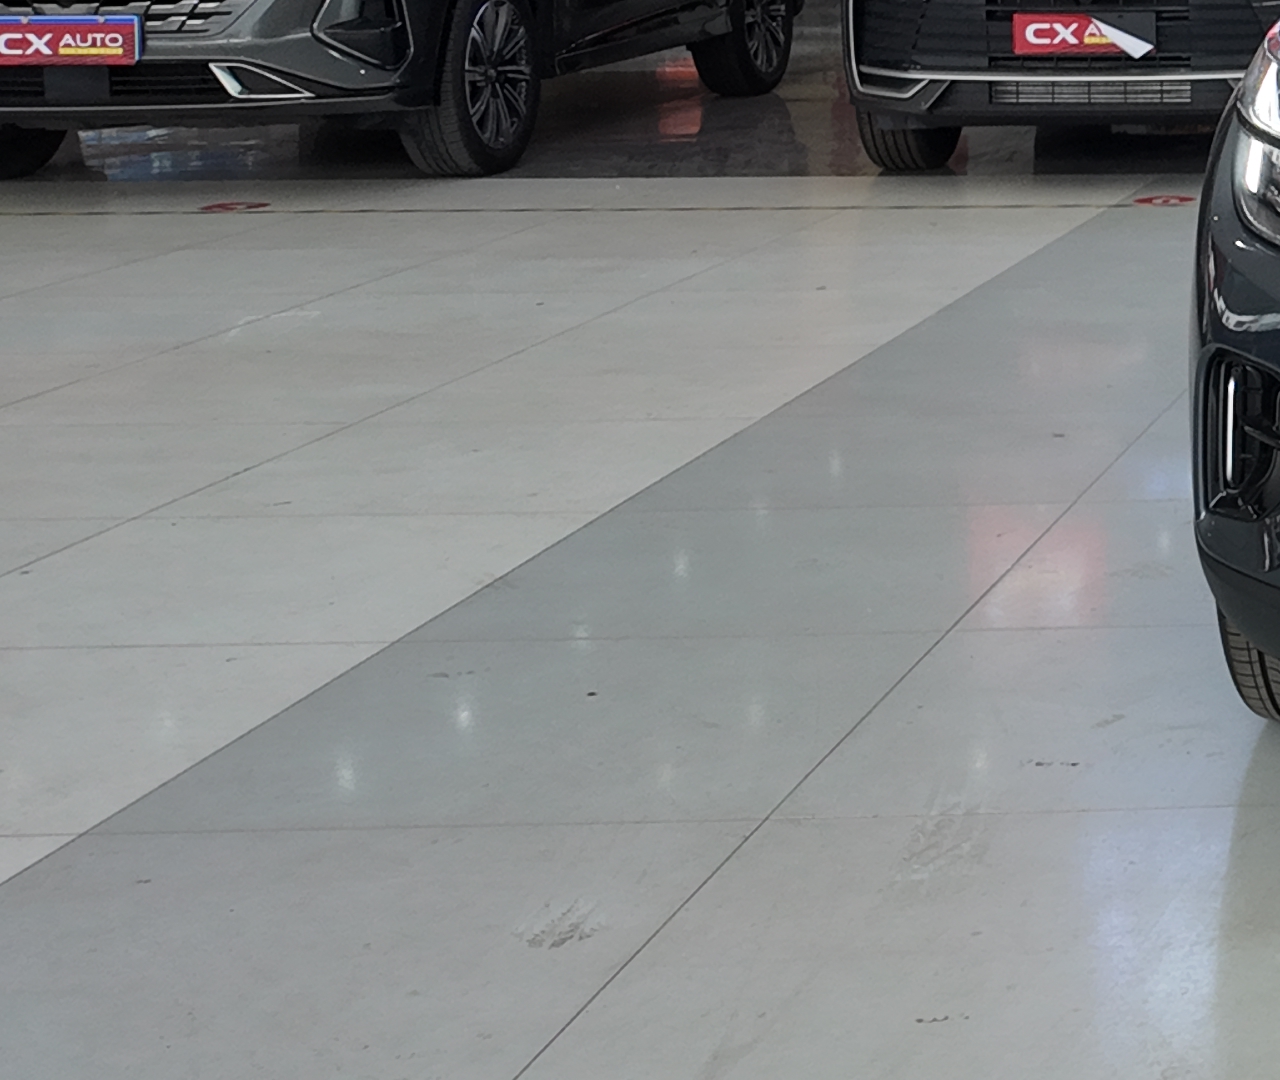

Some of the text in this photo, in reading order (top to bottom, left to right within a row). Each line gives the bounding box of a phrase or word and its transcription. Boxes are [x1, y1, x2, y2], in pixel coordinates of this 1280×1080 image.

[0, 32, 124, 55] CX AUTO
[1025, 22, 1080, 46] CX
